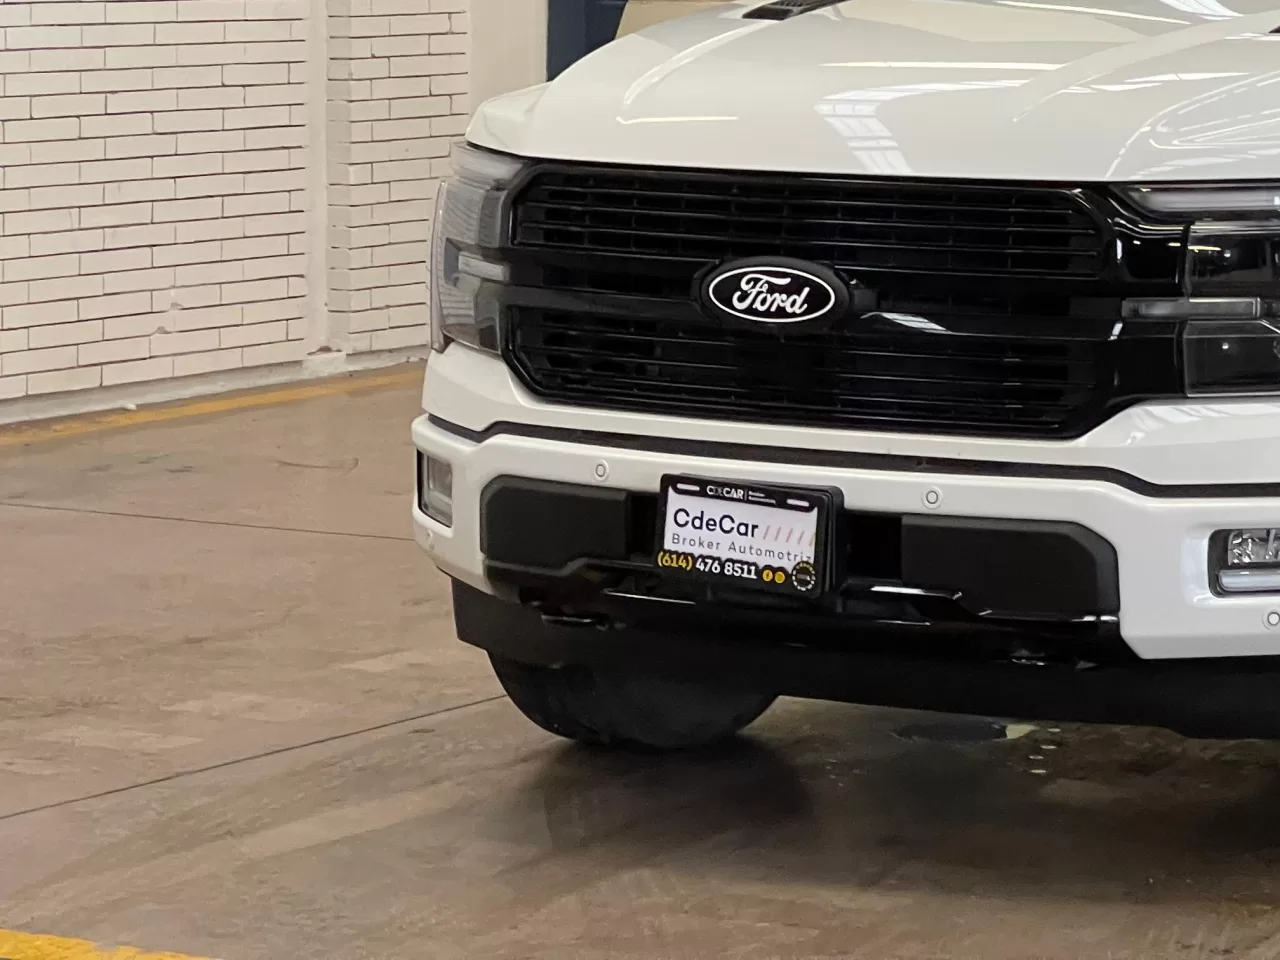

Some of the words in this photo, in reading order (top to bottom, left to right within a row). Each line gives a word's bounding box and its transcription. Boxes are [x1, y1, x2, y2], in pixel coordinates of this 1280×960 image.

[732, 273, 810, 314] Ford
[673, 508, 759, 538] CdeCar
[672, 533, 721, 550] Broker
[728, 541, 811, 563] Automotriz
[657, 551, 693, 571] (614)
[696, 557, 721, 573] 476
[724, 561, 758, 579] 8511
